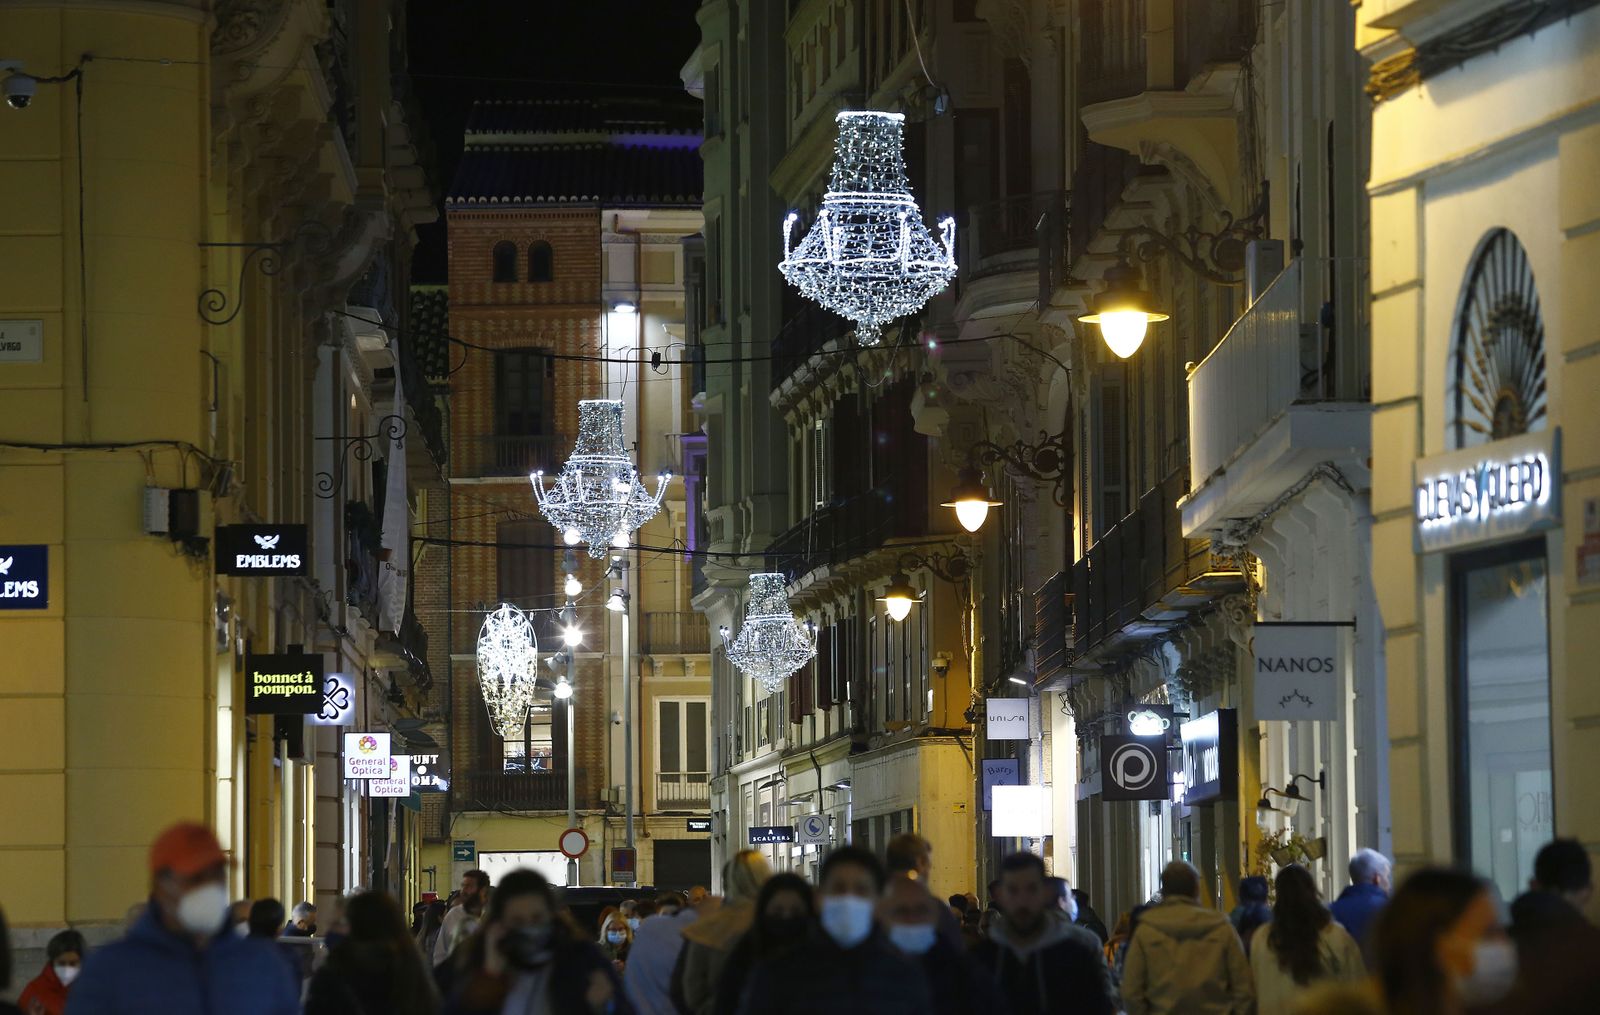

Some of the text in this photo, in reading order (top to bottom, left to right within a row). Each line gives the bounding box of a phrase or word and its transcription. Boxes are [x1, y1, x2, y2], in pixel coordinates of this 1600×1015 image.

[236, 554, 301, 568] EMBLEMS
[1257, 657, 1334, 674] NANOS
[253, 671, 303, 684] bonnet
[253, 685, 316, 697] pompon.
[348, 757, 386, 766] General
[351, 766, 383, 776] Optica
[987, 766, 1014, 776] Barry
[374, 785, 403, 795] Optica
